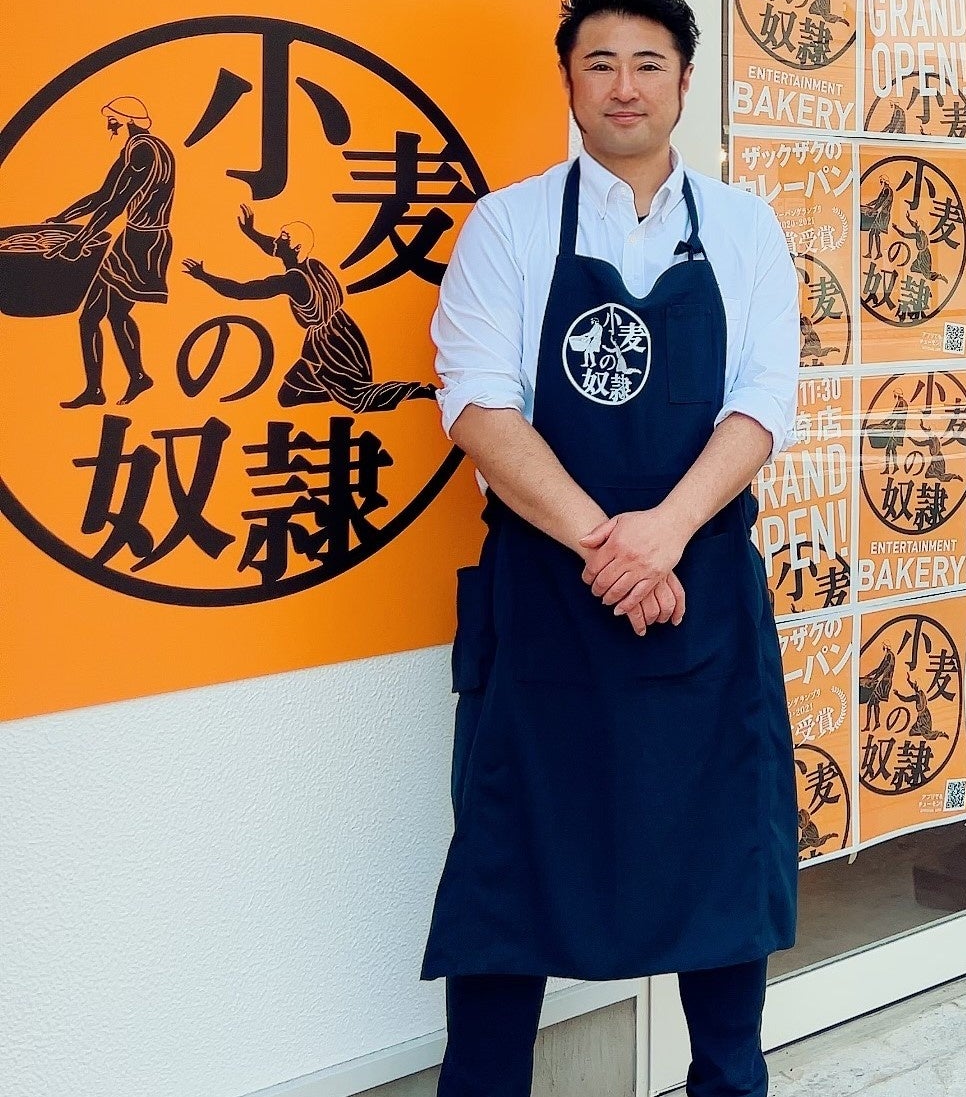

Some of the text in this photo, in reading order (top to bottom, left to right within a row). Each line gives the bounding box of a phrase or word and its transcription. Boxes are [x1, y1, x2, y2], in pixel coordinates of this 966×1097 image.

[759, 2, 834, 66] 奴隷
[733, 81, 855, 132] BAKERY
[748, 65, 844, 95] ENTERTAINMENT
[741, 140, 843, 171] ザックザクの
[896, 158, 965, 250] 小麦
[888, 241, 911, 267] の
[799, 267, 844, 325] 麦
[862, 262, 932, 322] 奴隷
[602, 305, 649, 354] 小麦
[176, 315, 275, 403] の
[581, 368, 633, 402] 奴隷
[600, 354, 616, 371] の
[752, 444, 848, 513] RAND
[904, 451, 925, 476] の
[73, 415, 393, 585] 奴隷
[881, 477, 949, 531] 奴隷
[752, 499, 849, 578] PEN!
[870, 539, 957, 555] ENTERTAINMENT
[858, 555, 966, 592] BAKERY
[897, 617, 958, 703] 小麦
[886, 706, 911, 734] の
[794, 758, 842, 816] 麦
[861, 734, 935, 792] 奴隷
